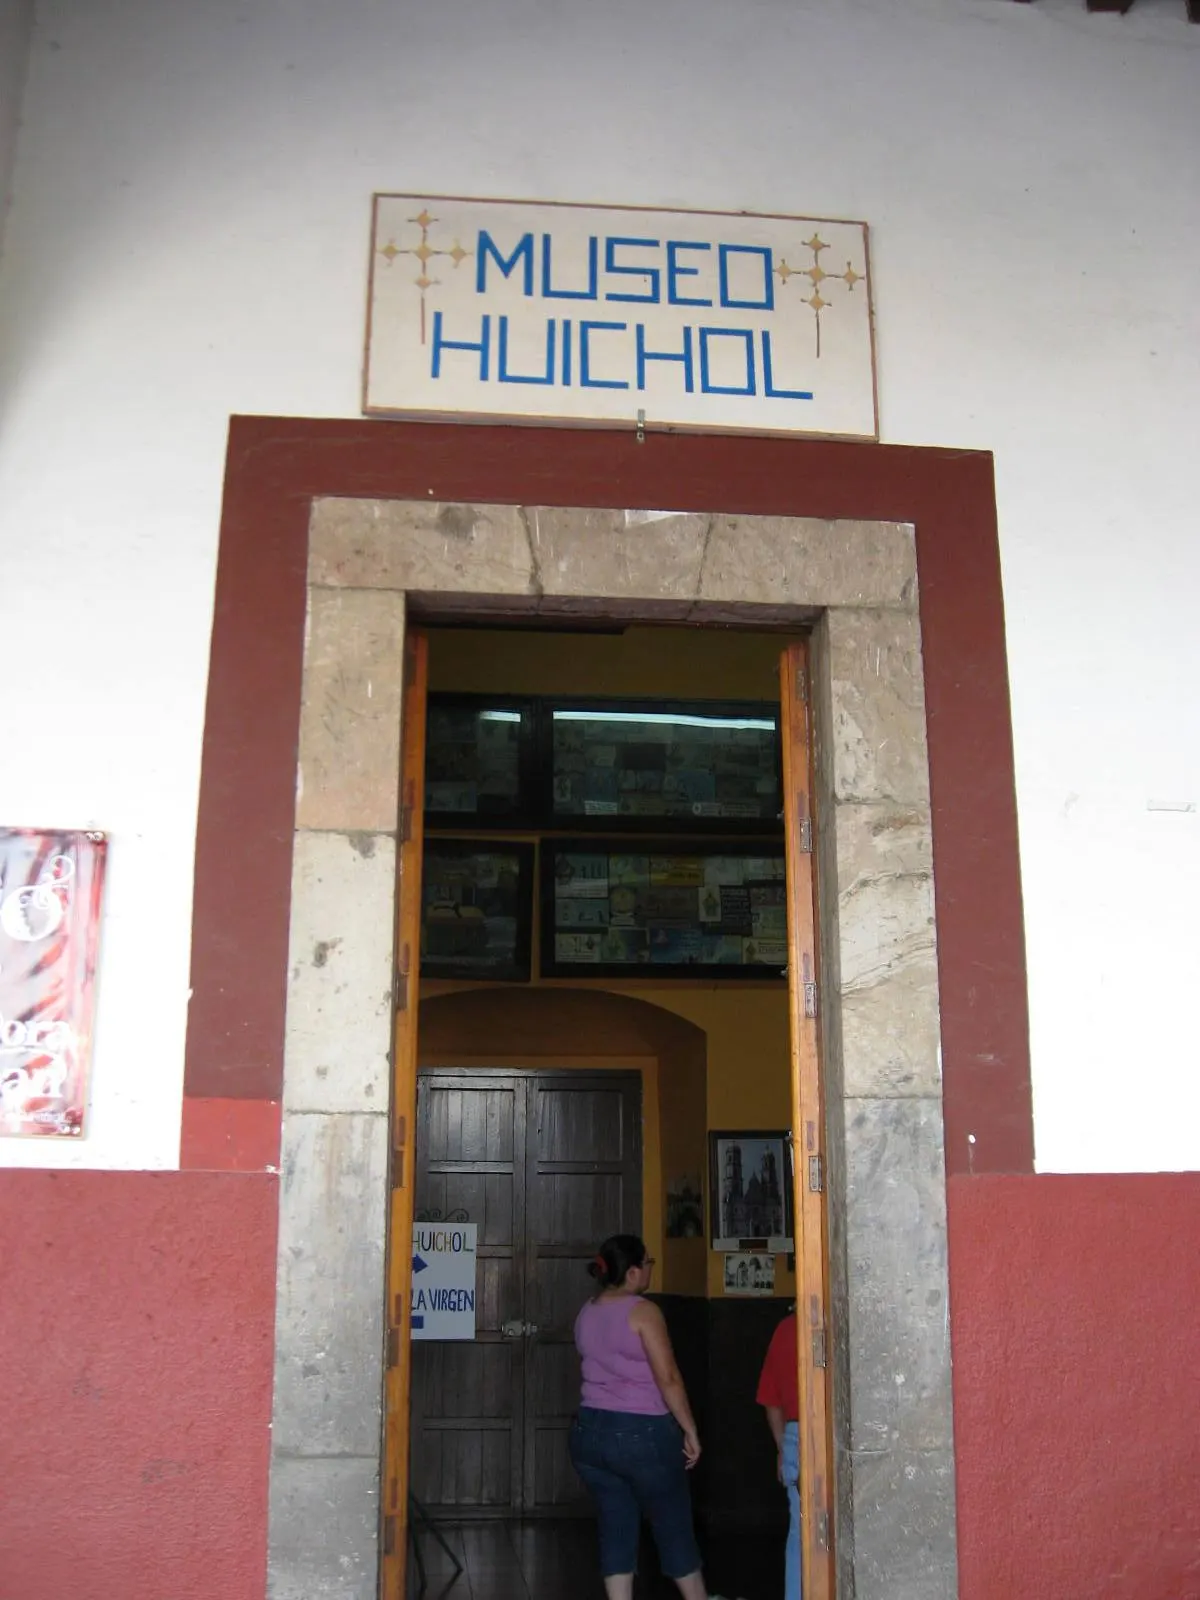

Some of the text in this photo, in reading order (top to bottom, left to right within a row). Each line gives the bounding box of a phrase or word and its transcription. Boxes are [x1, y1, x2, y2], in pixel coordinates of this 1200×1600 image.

[476, 230, 775, 310] MUSEO
[431, 311, 814, 400] HUICHOL
[428, 1287, 475, 1313] VIRGEN
